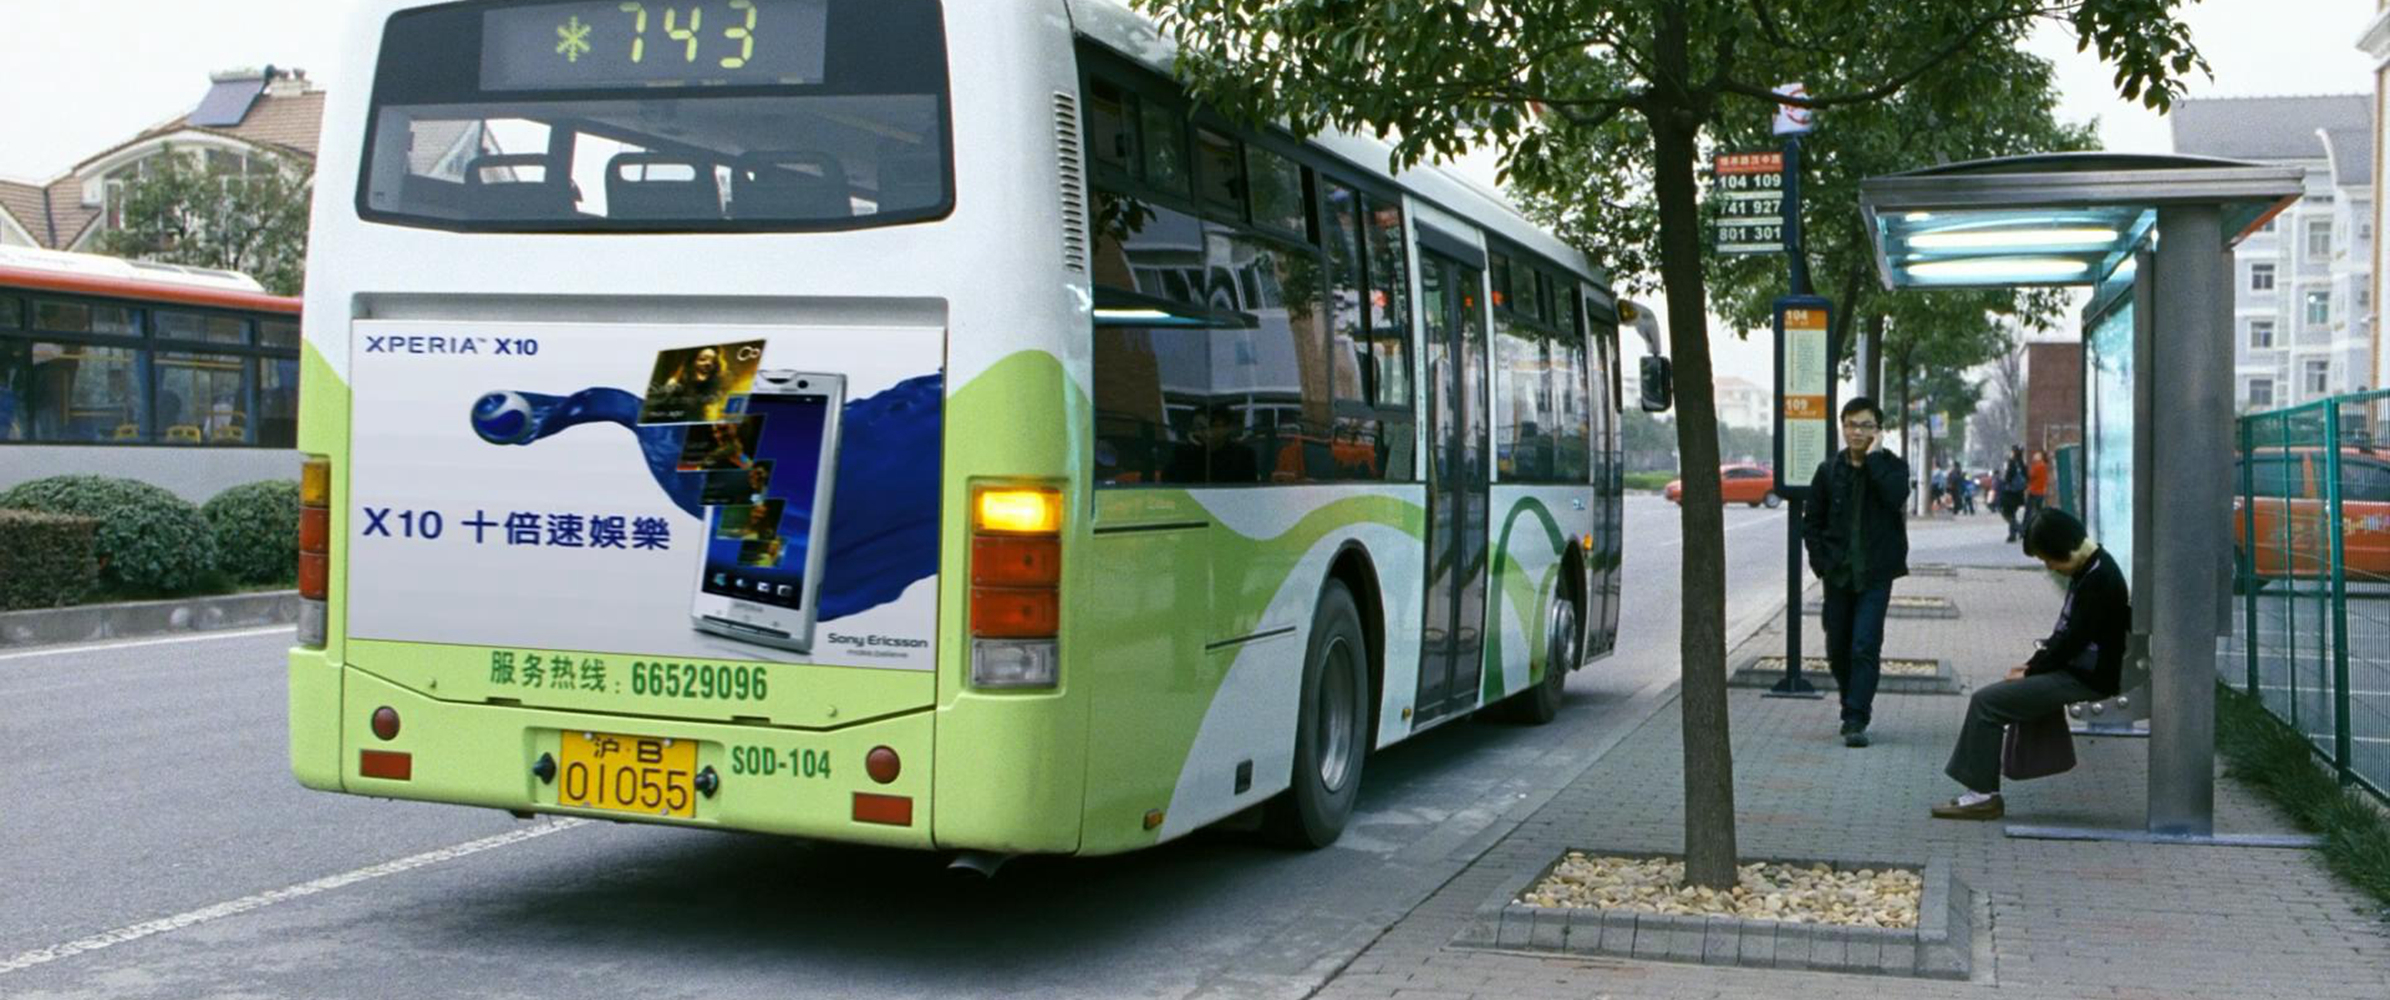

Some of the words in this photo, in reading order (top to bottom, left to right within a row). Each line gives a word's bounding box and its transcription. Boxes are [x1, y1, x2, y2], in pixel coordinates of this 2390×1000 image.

[618, 0, 757, 69] 743
[1720, 174, 1747, 189] 104
[1753, 173, 1782, 188] 109
[1720, 200, 1746, 215] 741
[1753, 199, 1782, 214] 927
[1719, 226, 1746, 241] 801
[1754, 226, 1781, 240] 301
[493, 337, 539, 356] X10
[362, 506, 444, 540] X10
[460, 509, 671, 551] 十倍速娛樂
[827, 632, 865, 648] Sony
[867, 634, 929, 649] Ericsson
[631, 661, 768, 701] 66529096
[731, 745, 832, 779] SOD-104
[565, 761, 688, 811] 01055
